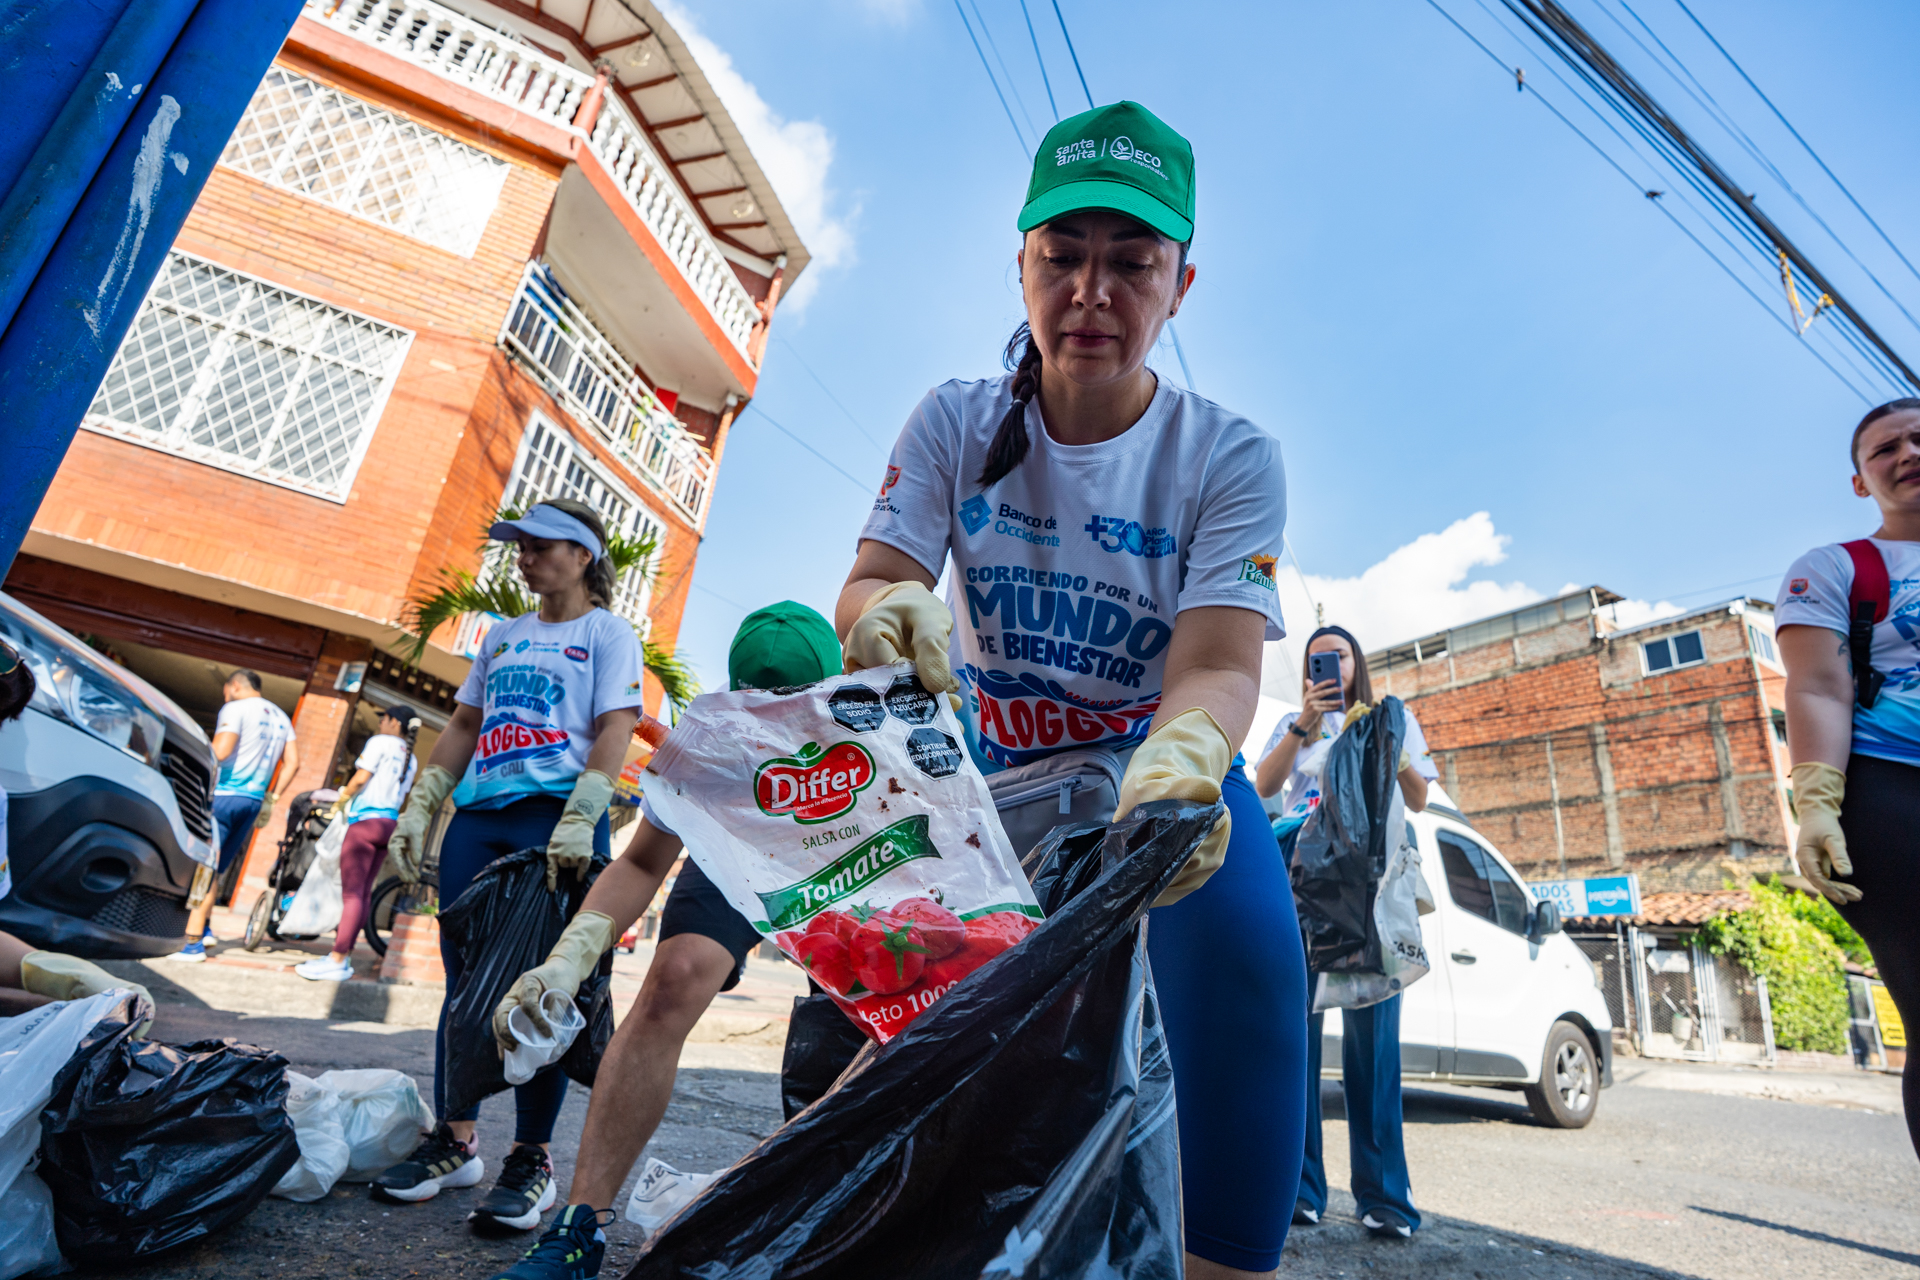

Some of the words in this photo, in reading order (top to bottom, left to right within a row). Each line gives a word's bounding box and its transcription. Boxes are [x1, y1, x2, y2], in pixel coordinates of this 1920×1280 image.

[1055, 139, 1095, 158] santa
[1057, 149, 1097, 167] anita
[1134, 149, 1161, 168] ECO
[998, 503, 1042, 528] Banco
[1044, 515, 1057, 530] de
[994, 520, 1060, 547] Occidente
[1146, 527, 1167, 536] AÑOS
[1143, 536, 1177, 559] azul
[966, 565, 1089, 592] CORRIENDO
[1093, 581, 1131, 603] POR
[1137, 594, 1159, 614] UN
[965, 582, 1172, 661] MUNDO
[976, 634, 999, 655] DE
[1003, 632, 1146, 689] BIENESTAR
[486, 672, 566, 706] MUNDO
[891, 693, 918, 704] EXCESO
[918, 691, 928, 699] EN
[494, 694, 552, 718] BIENESTAR
[836, 702, 864, 711] EXCESO
[865, 700, 874, 708] EN
[846, 709, 872, 718] SODIO
[911, 747, 961, 762] EDULCORANTES
[916, 742, 949, 752] CONTIENE
[500, 761, 525, 778] CALI
[771, 766, 861, 809] Differ
[796, 803, 815, 811] Marca
[802, 831, 838, 850] SALSA
[838, 824, 861, 840] CON
[797, 840, 895, 910] Tomate
